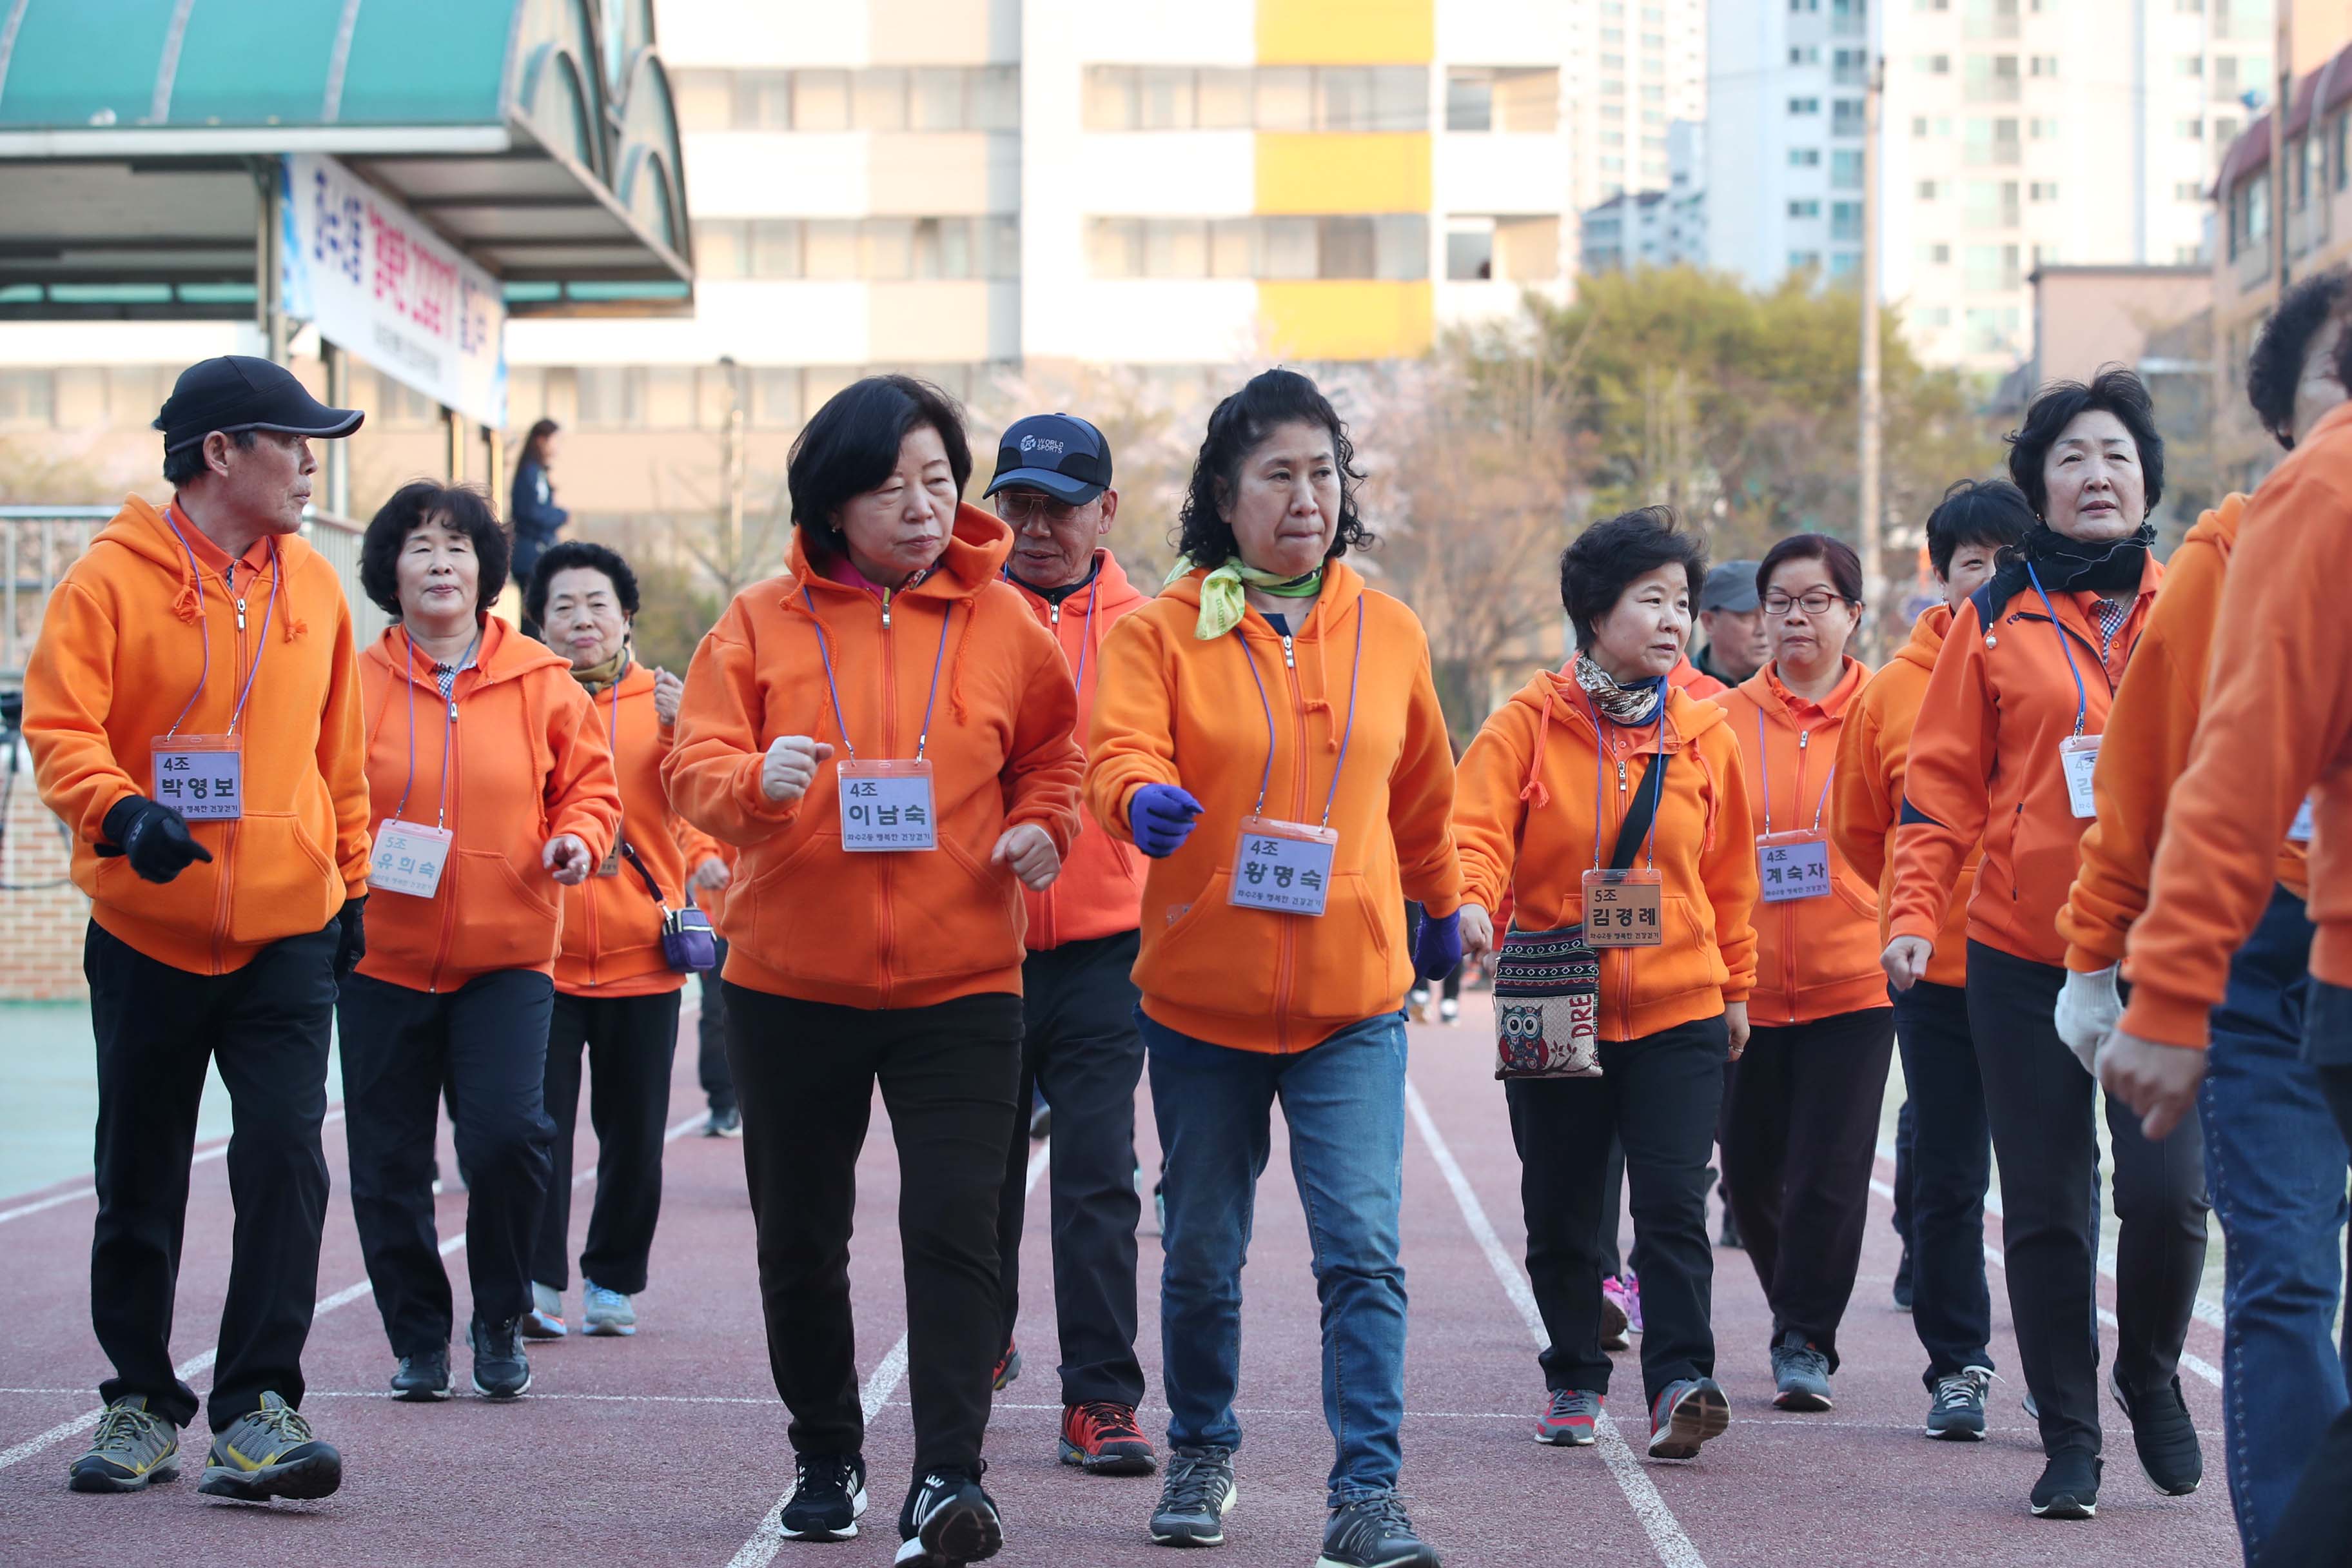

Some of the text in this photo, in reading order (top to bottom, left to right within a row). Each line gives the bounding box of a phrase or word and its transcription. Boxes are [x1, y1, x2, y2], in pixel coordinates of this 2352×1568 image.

[1037, 444, 1063, 453] SPORTS
[1038, 438, 1064, 447] WORLD
[163, 757, 190, 771] 4조
[162, 778, 235, 799] 박영보
[850, 782, 878, 798] 4조
[186, 805, 208, 813] 행복한
[210, 805, 238, 813] 건강걷기
[848, 805, 925, 826] 이남숙
[385, 837, 407, 850] 5조
[876, 833, 898, 841] 행복한
[901, 833, 930, 841] 건강걷기
[1250, 840, 1279, 856] 4조
[1767, 850, 1788, 863] 4조
[1244, 861, 1322, 891] 황명숙
[1767, 862, 1825, 884] 계숙자
[1594, 889, 1618, 902] 5조
[1593, 908, 1656, 926] 김경례
[1569, 994, 1593, 1039] DRE
